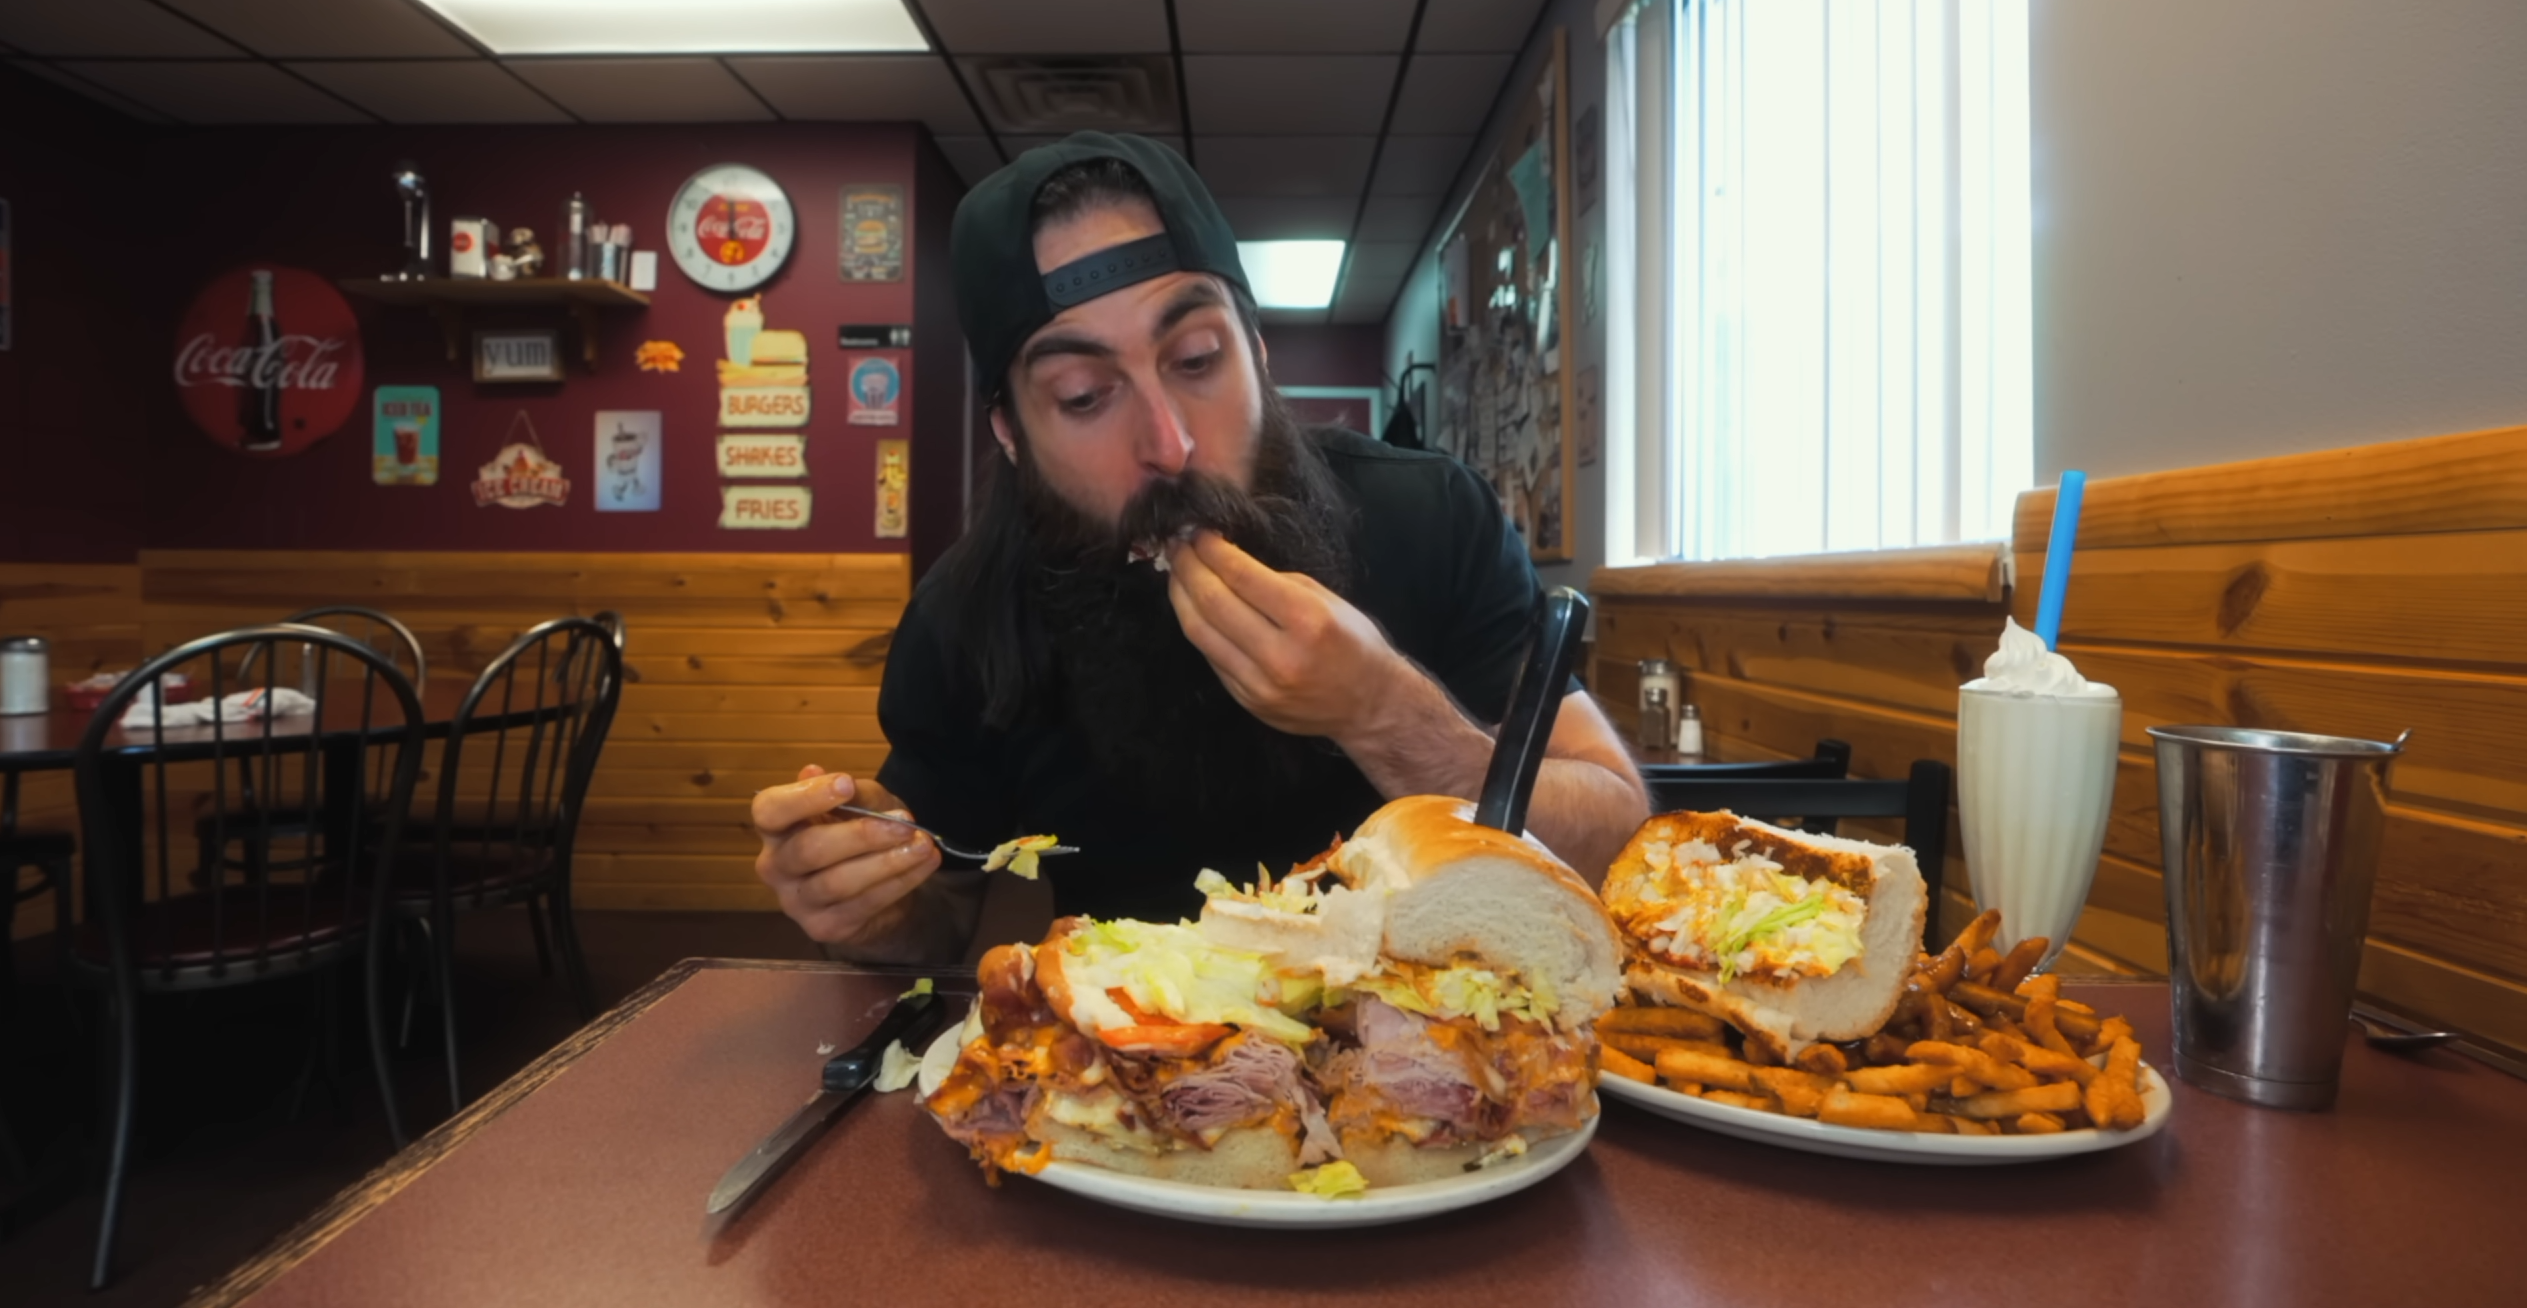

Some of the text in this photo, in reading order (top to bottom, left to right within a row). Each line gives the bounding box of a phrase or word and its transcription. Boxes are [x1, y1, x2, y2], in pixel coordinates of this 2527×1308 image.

[697, 216, 767, 240] CocaCola
[174, 333, 345, 390] Coca-Cola
[484, 342, 547, 376] yum
[727, 394, 805, 416] BURGERS
[724, 445, 798, 467] SHAKES
[735, 499, 800, 520] FRIES
